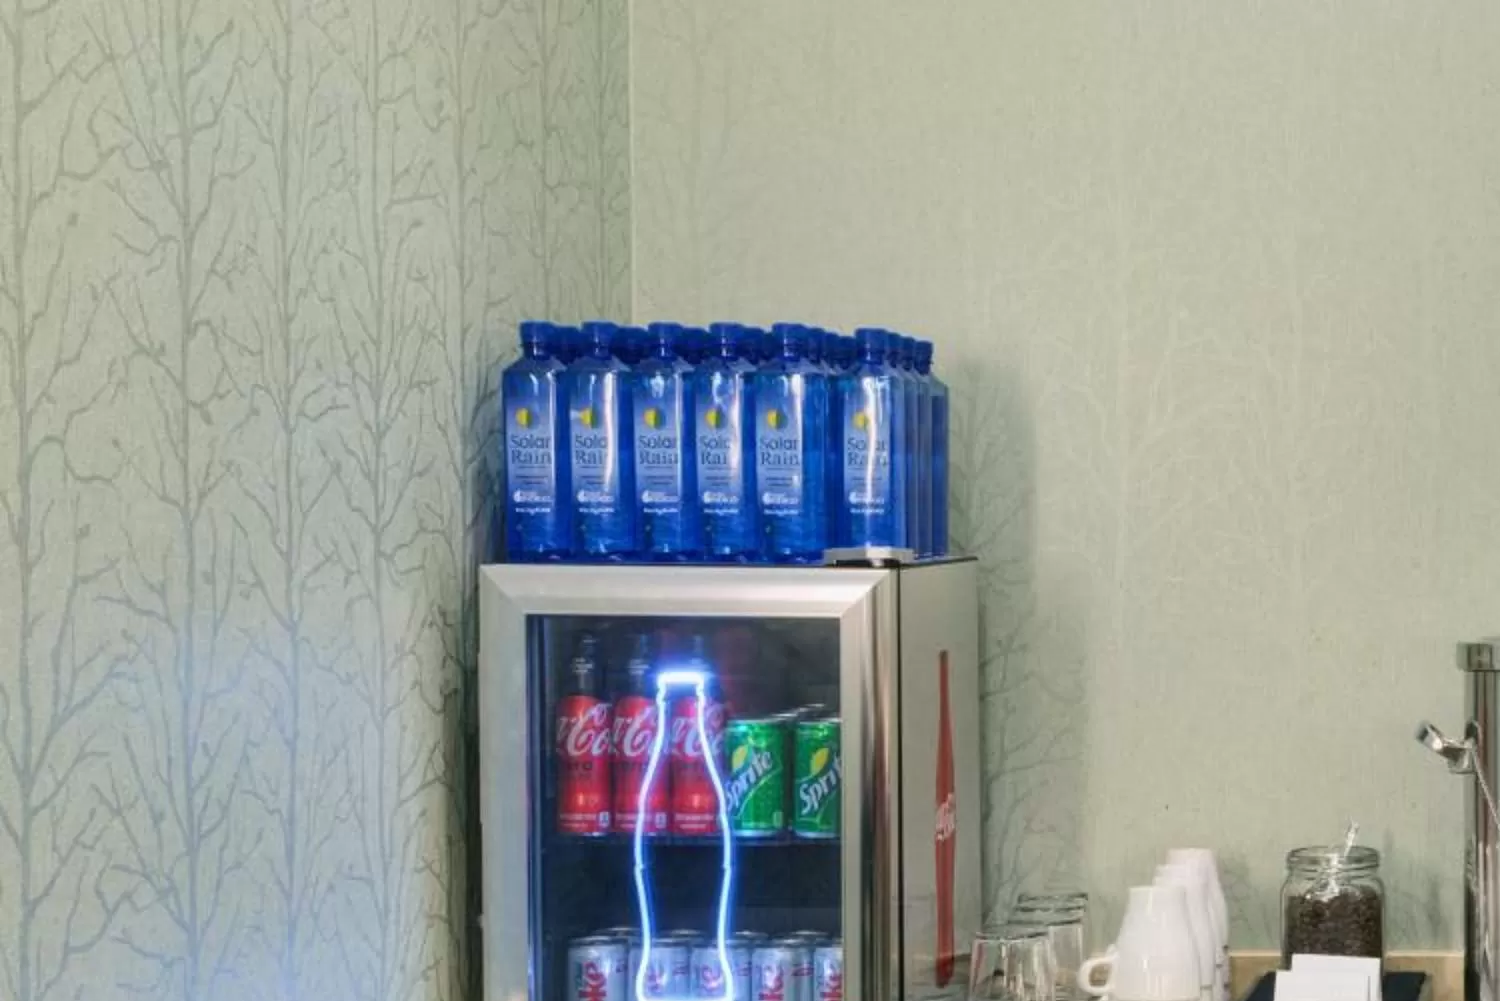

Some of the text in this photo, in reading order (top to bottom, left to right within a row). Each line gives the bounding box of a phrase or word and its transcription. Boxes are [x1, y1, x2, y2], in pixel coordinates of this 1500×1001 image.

[510, 435, 551, 449] Solar
[575, 435, 608, 449] Sola
[699, 435, 731, 449] Sola
[759, 435, 800, 449] Solar
[847, 437, 887, 450] Soar
[511, 450, 552, 465] Rain
[575, 450, 607, 464] Rai
[700, 451, 730, 465] Rai
[760, 451, 801, 465] Rain
[847, 451, 889, 466] Ran
[799, 751, 842, 816] Sprit
